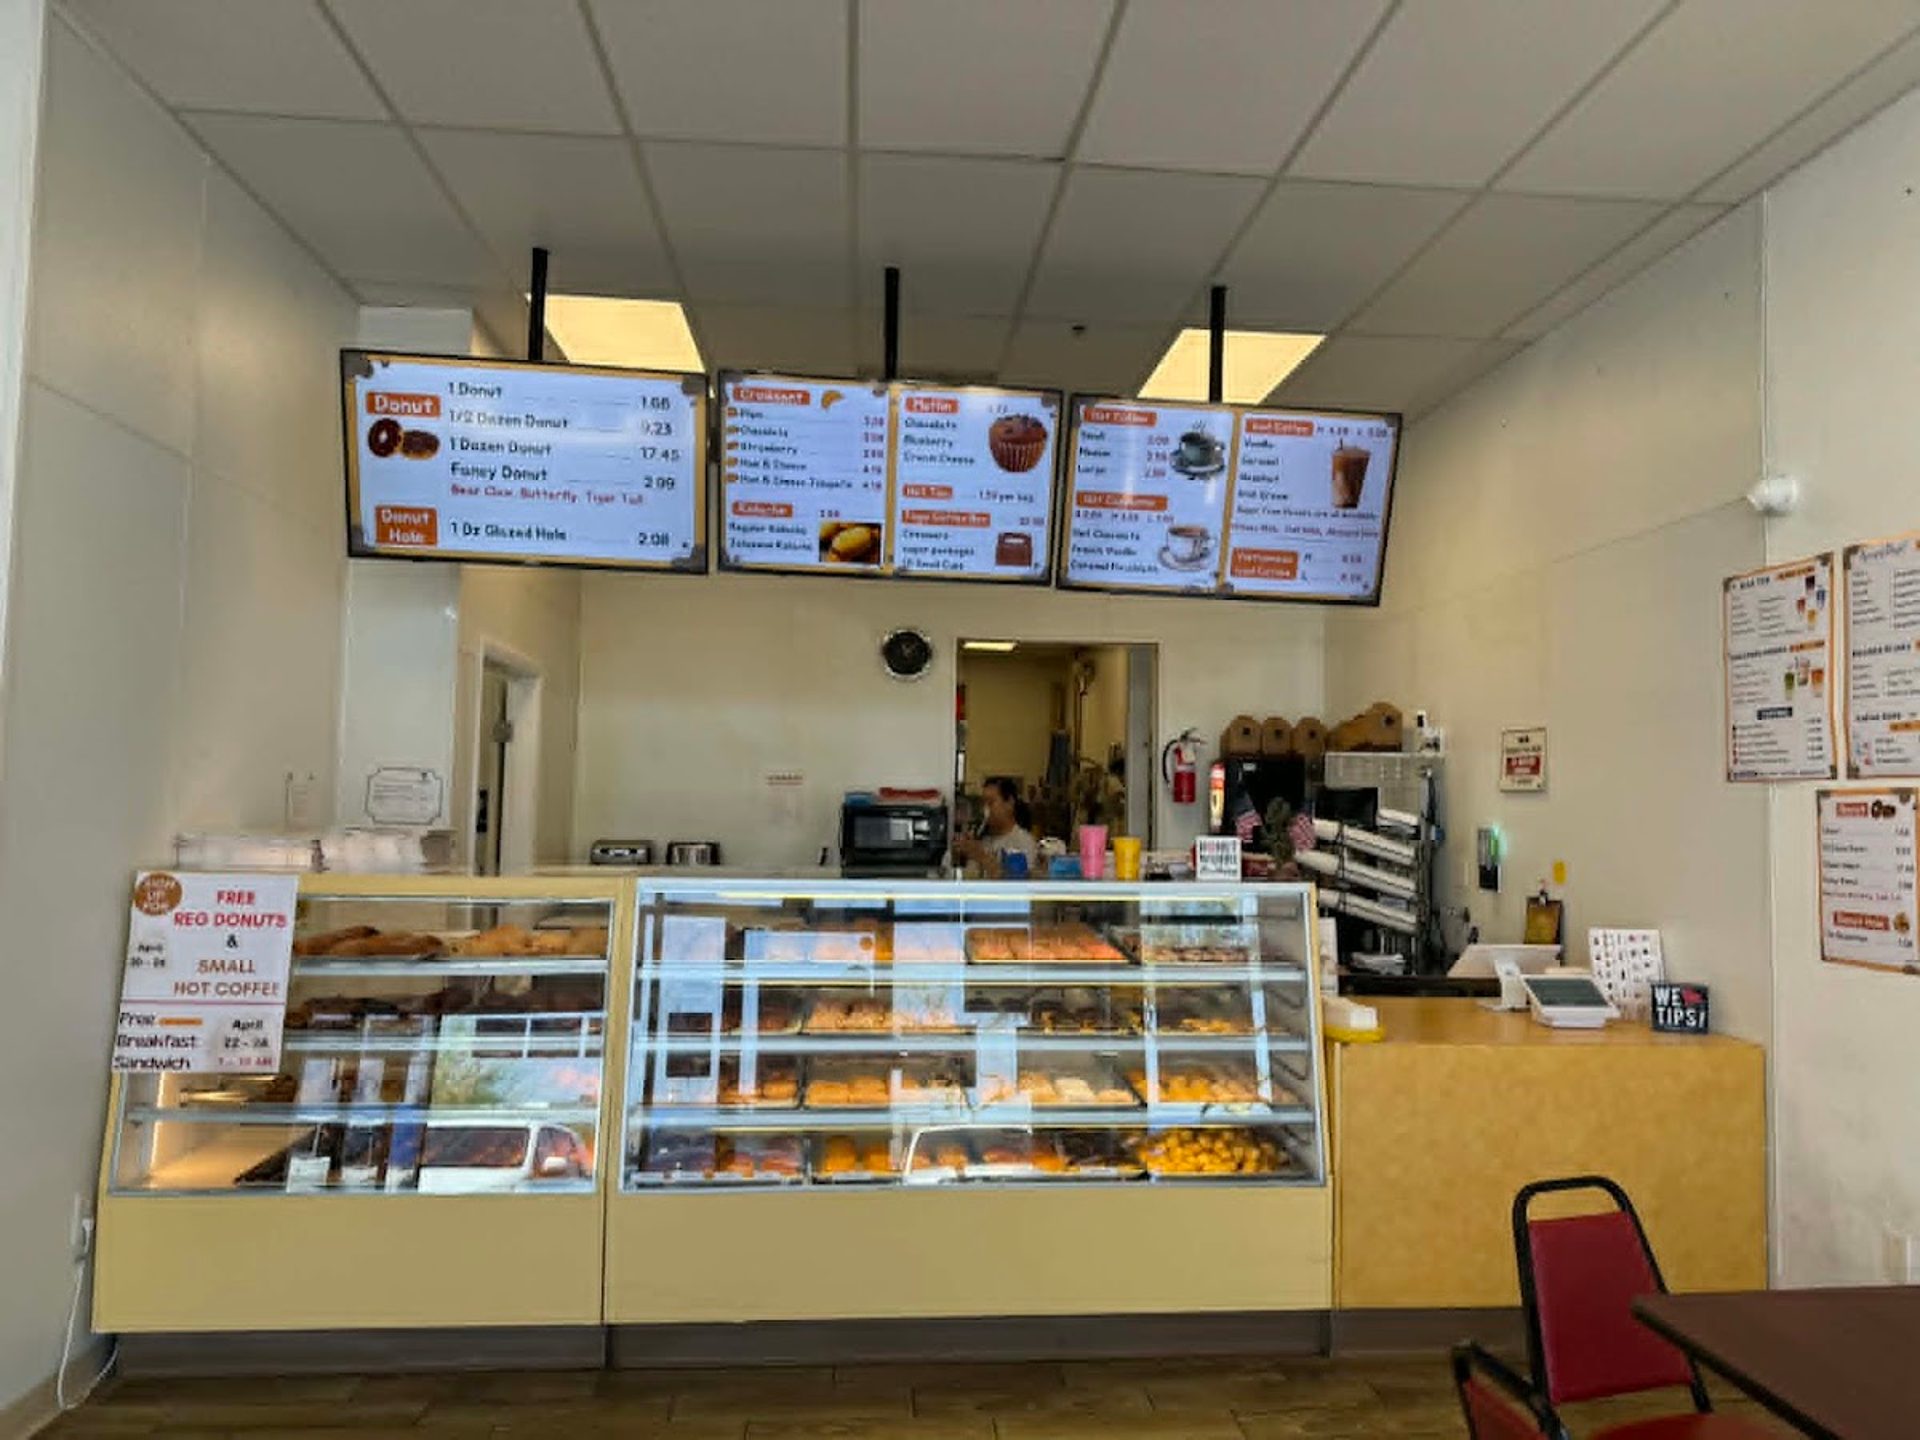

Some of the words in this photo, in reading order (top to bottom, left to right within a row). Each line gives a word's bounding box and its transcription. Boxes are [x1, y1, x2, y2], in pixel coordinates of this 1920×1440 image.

[458, 382, 503, 398] Donut
[374, 395, 434, 414] Donut
[449, 410, 474, 424] 1/2
[524, 414, 569, 430] Donut
[459, 438, 506, 454] Dozen
[507, 441, 552, 457] Donut
[450, 462, 497, 482] Fancy
[501, 465, 549, 481] Donut
[380, 508, 430, 526] Donut
[388, 528, 425, 545] Hole
[484, 523, 533, 540] Glazed
[535, 526, 568, 542] Hole
[217, 890, 256, 905] FREE
[213, 913, 287, 929] DONUTS
[226, 934, 239, 949] &
[197, 959, 256, 974] SMALL
[173, 982, 210, 996] HOT
[215, 982, 280, 997] COFFEE
[1653, 986, 1681, 1006] WE
[118, 1012, 156, 1026] Free
[1655, 1006, 1705, 1028] TIPS!
[232, 1019, 264, 1032] April
[116, 1034, 197, 1049] Breakfast
[113, 1056, 191, 1071] Sandwich
